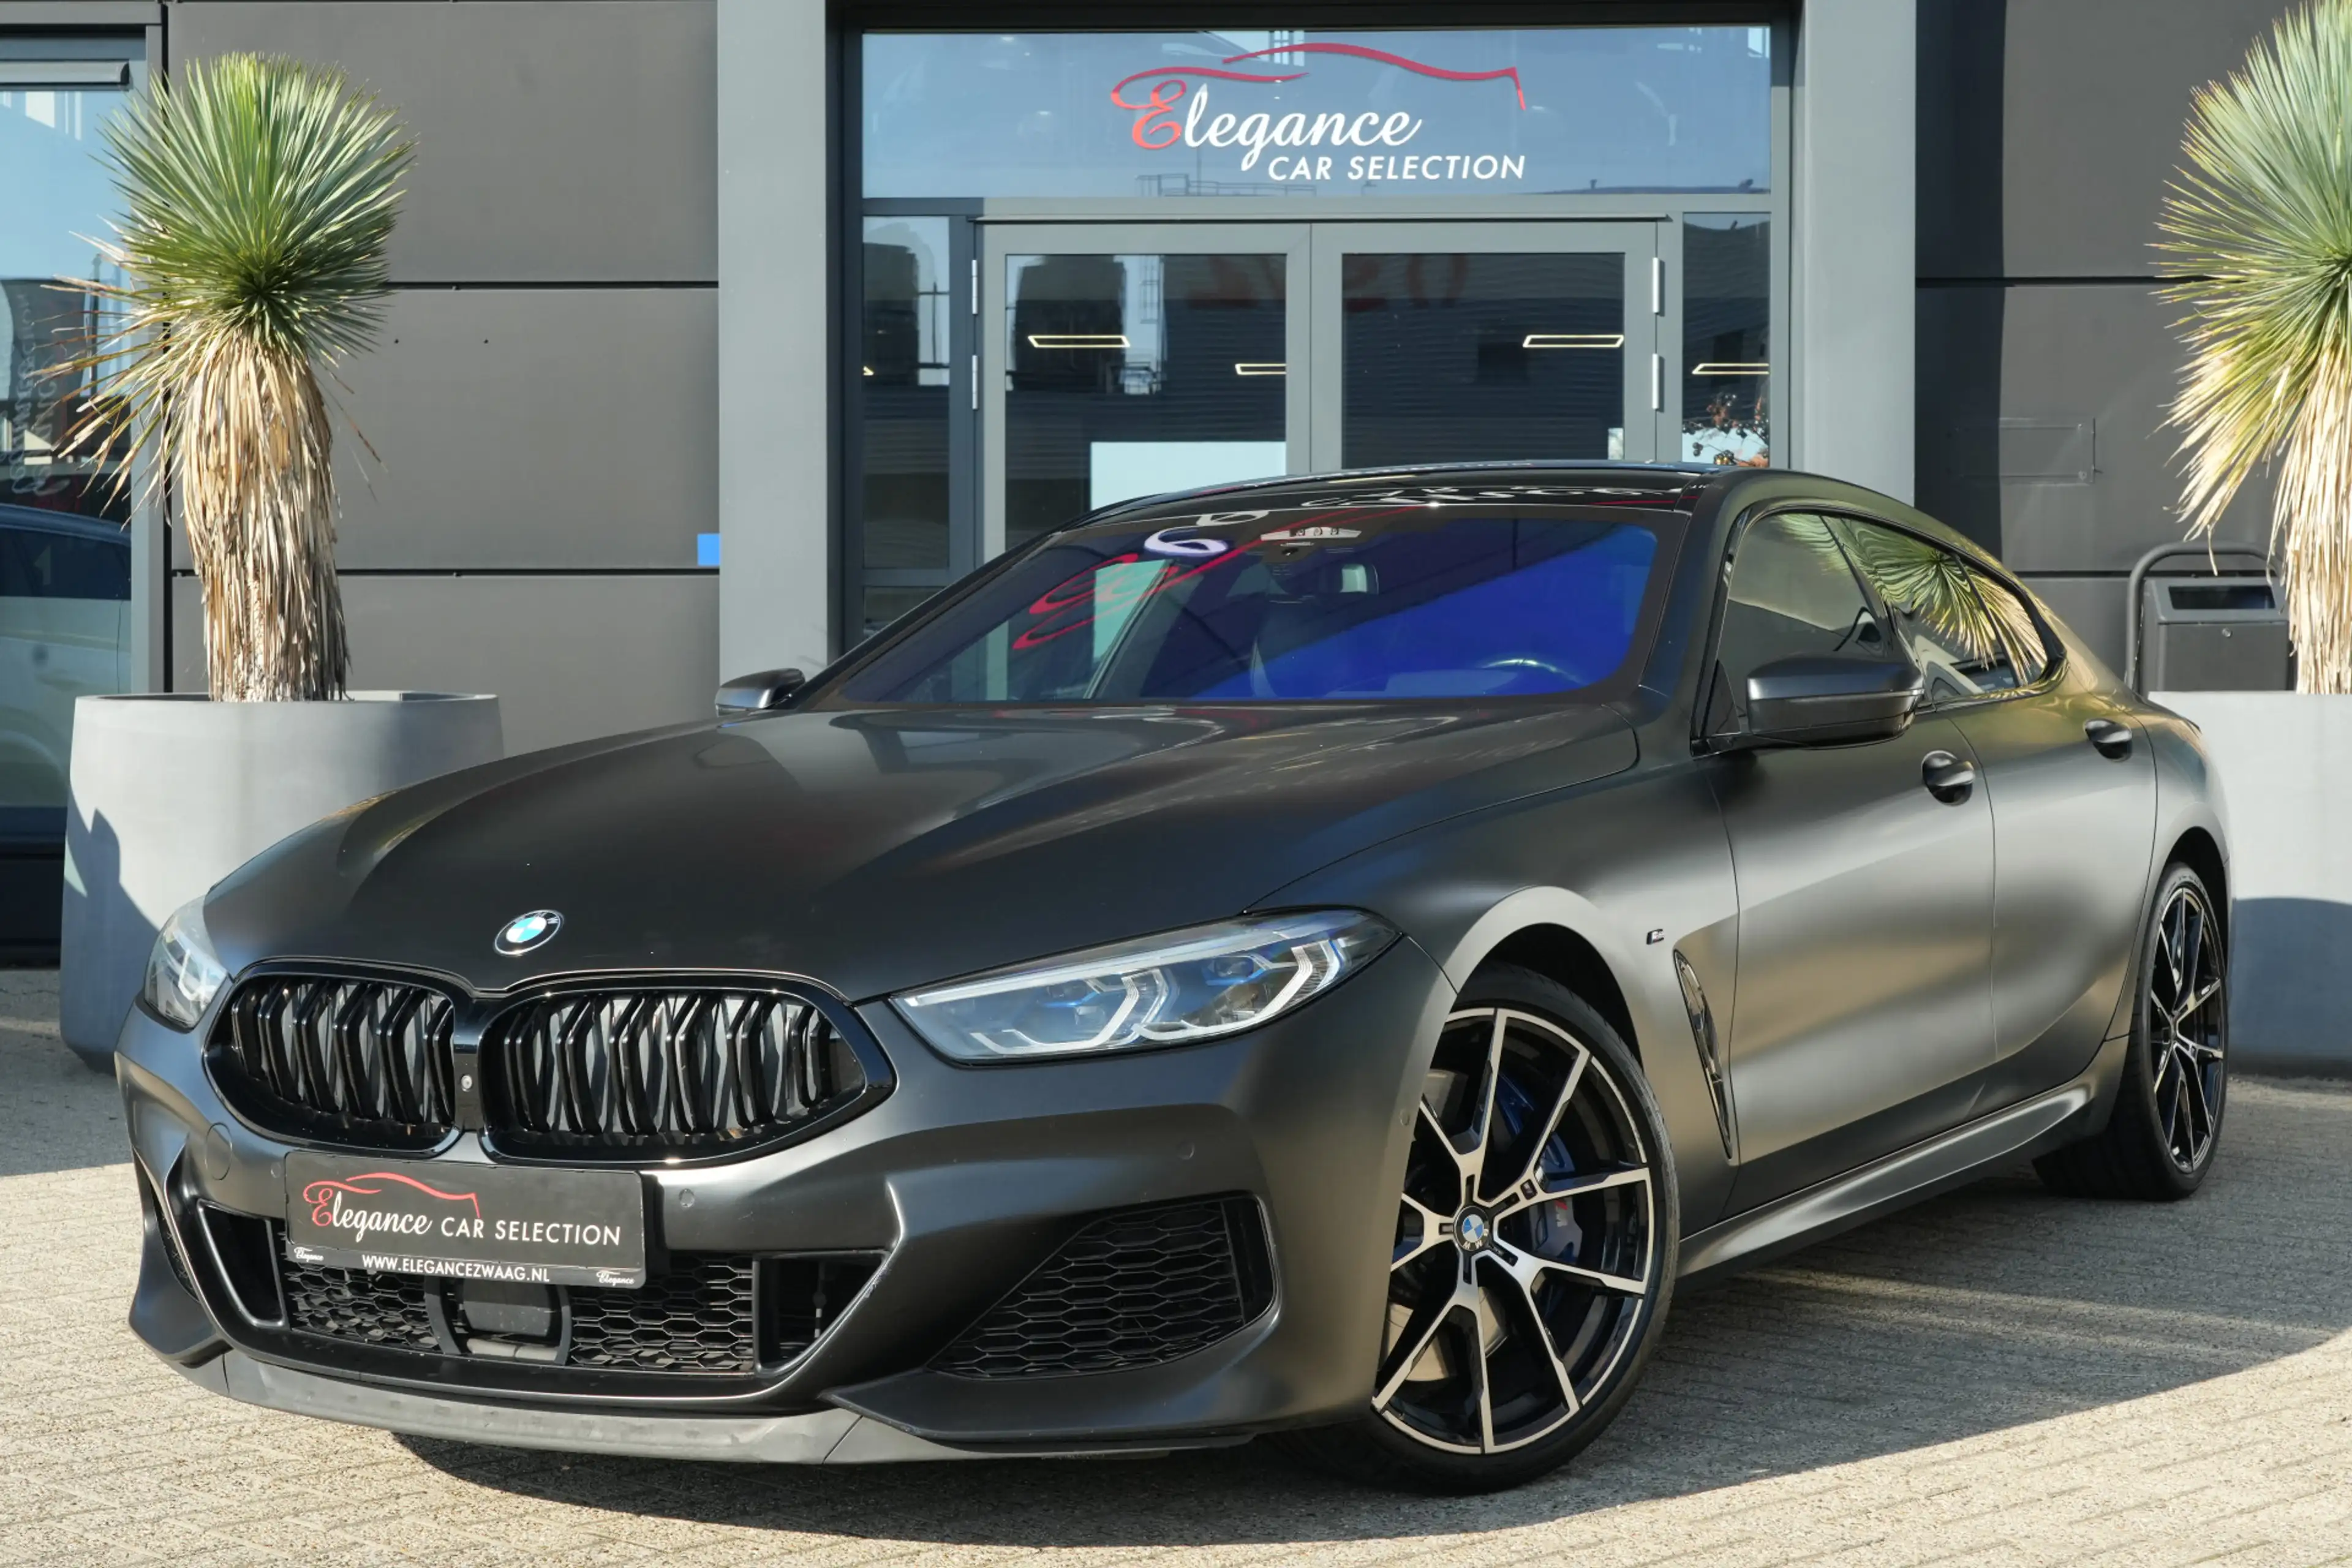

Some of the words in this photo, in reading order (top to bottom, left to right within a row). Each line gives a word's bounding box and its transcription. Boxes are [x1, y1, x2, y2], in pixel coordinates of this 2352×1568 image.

[1110, 67, 1422, 172] Elegance
[1268, 156, 1333, 181] CAR
[1348, 154, 1526, 180] SELECTION
[303, 1182, 432, 1242] Elegance
[440, 1216, 484, 1238] CAR
[495, 1220, 621, 1246] SELECTION
[362, 1254, 551, 1283] WWW.ELEGANCEZWAAG.NL
